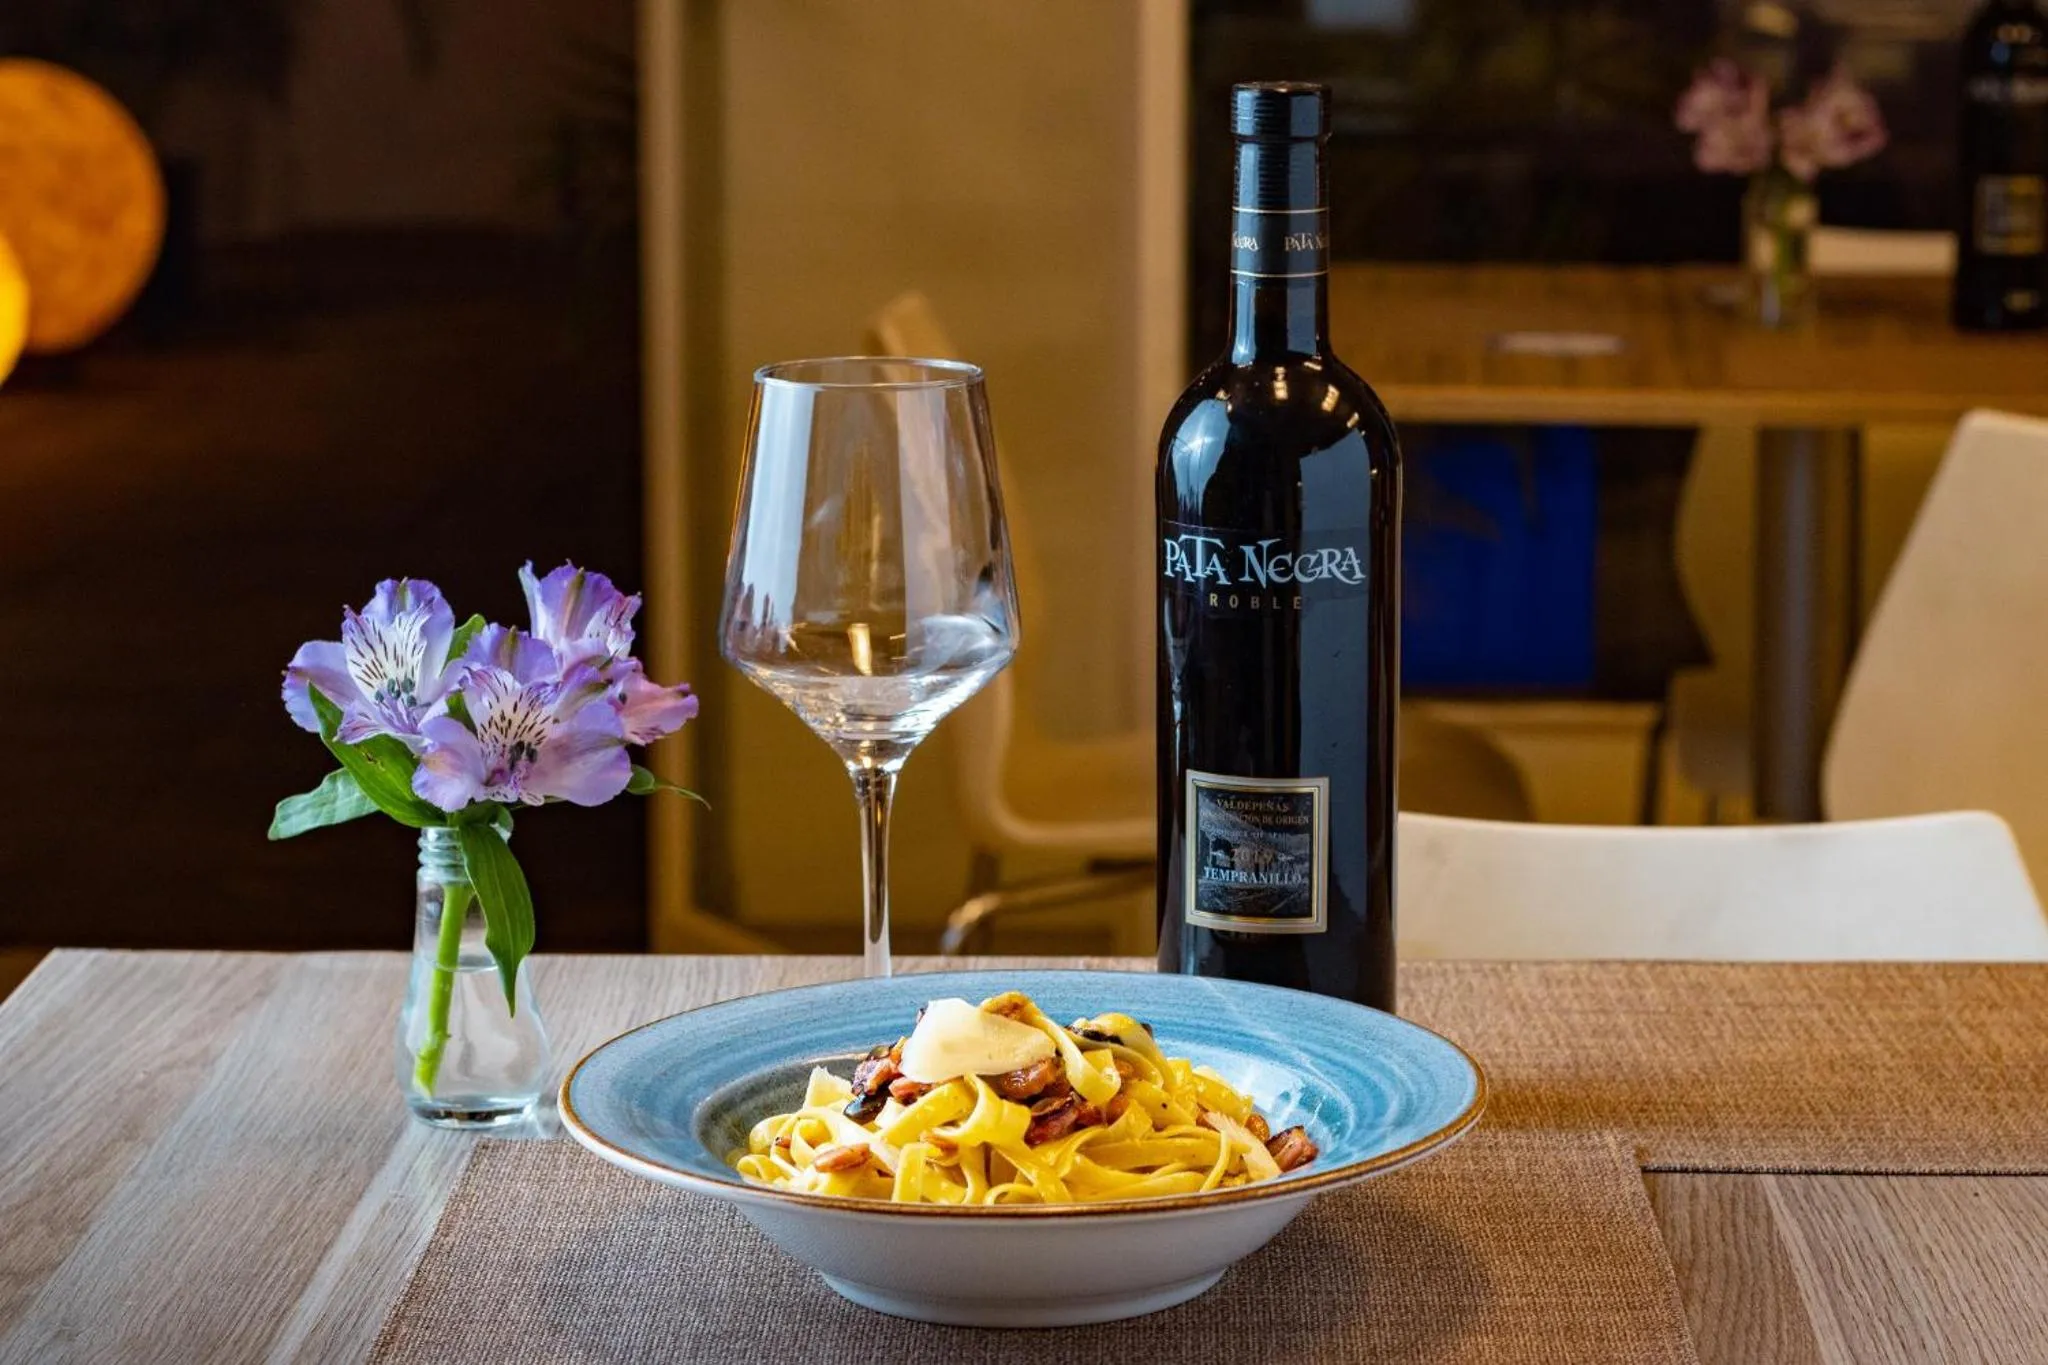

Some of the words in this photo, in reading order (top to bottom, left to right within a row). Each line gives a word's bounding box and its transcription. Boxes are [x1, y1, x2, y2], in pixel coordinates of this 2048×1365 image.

[1284, 232, 1315, 251] PATA
[1164, 534, 1232, 585] PATA
[1238, 538, 1366, 589] NEGRA
[1209, 592, 1302, 610] ROBLE
[1217, 799, 1290, 812] VALDEPEÑAS
[1203, 866, 1302, 884] TEMPRANILLO
